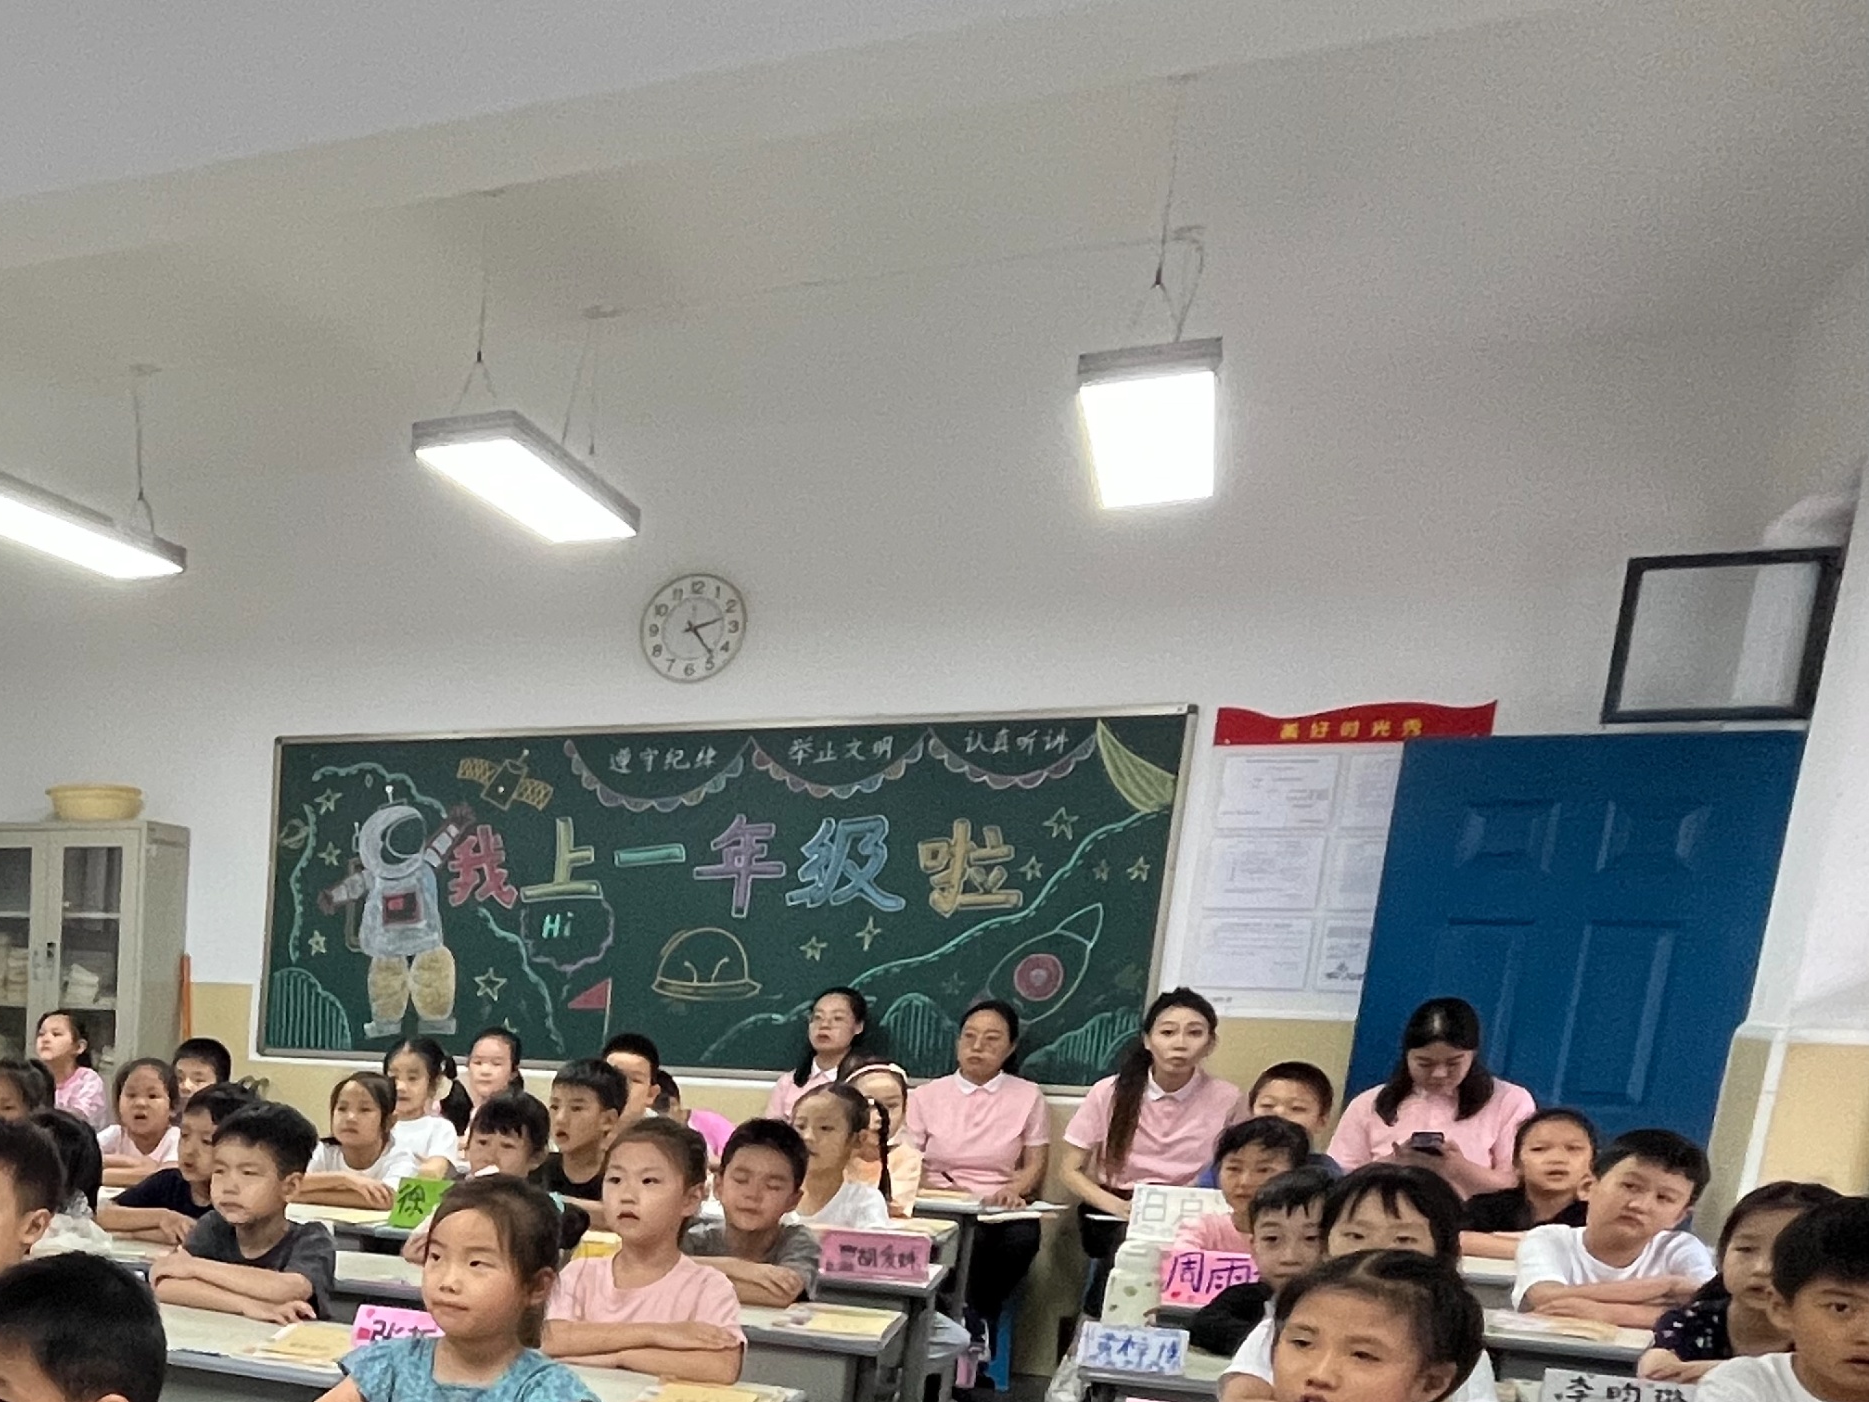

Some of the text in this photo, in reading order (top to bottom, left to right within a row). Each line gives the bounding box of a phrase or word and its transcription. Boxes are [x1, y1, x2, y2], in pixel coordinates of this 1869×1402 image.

[672, 588, 683, 601] 11
[691, 580, 705, 595] 12
[715, 586, 721, 599] 1
[655, 603, 669, 616] 10
[725, 599, 737, 613] 2
[649, 623, 659, 637] 9
[728, 620, 739, 633] 3
[651, 644, 662, 657] 8
[720, 641, 730, 652] 4
[666, 659, 676, 672] 7
[684, 663, 696, 676] 6
[705, 657, 715, 671] 5
[1280, 718, 1423, 741] 美好时光秀
[964, 727, 1070, 756] 认真听讲
[788, 735, 895, 766] 举止文明
[608, 745, 718, 774] 遵守纪律
[447, 814, 1023, 918] 我上一年级啦
[541, 911, 573, 939] Hi
[1163, 1251, 1259, 1295] 周雨
